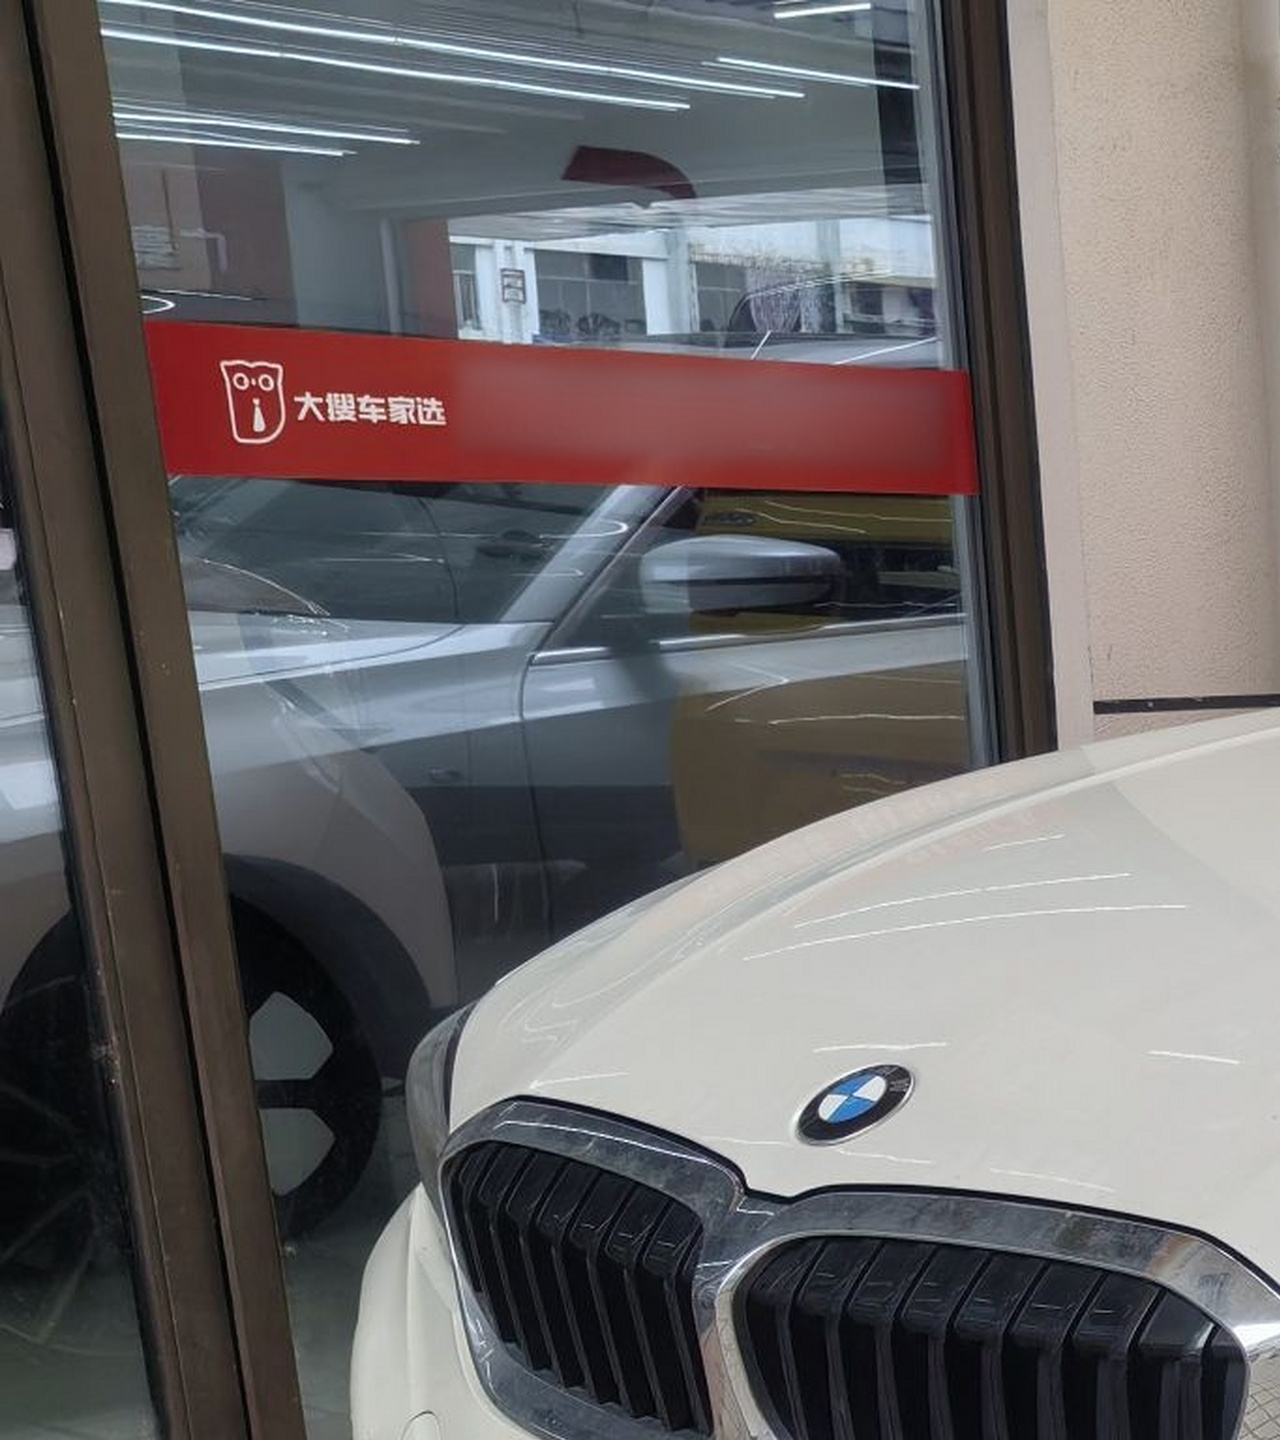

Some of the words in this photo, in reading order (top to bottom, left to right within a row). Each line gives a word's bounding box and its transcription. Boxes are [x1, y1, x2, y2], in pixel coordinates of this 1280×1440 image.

[294, 391, 447, 426] 大搜车家选
